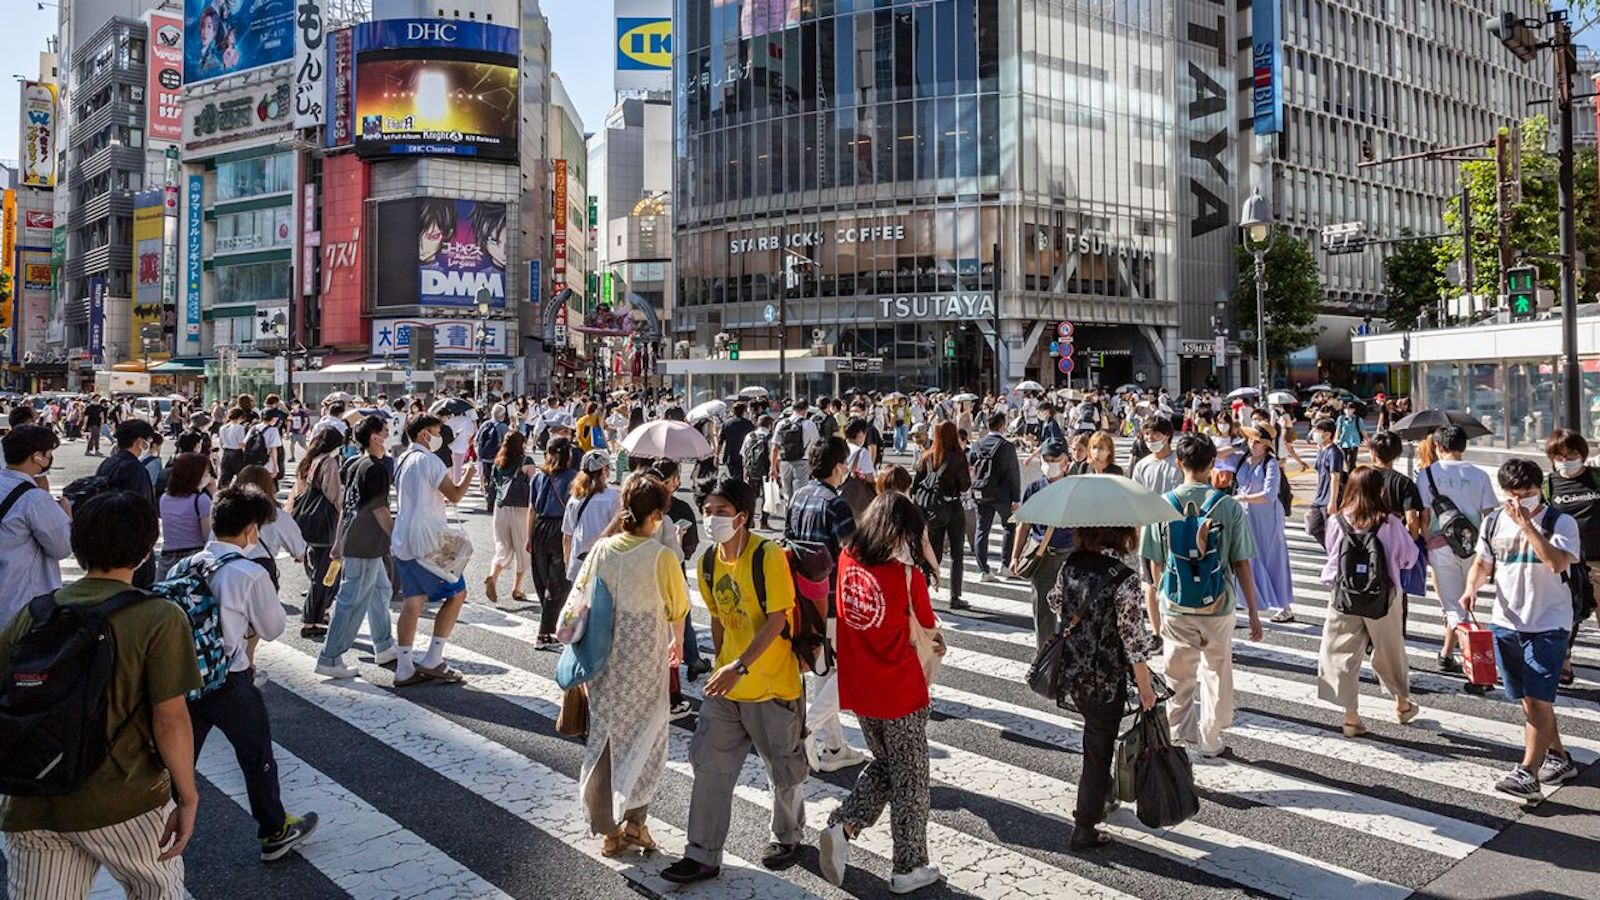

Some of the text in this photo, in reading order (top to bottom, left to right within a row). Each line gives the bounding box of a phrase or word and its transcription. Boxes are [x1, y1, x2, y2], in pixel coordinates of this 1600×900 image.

[407, 23, 457, 41] DHC
[297, 0, 322, 122] もんじゃ
[1254, 42, 1274, 118] SEIBU
[159, 92, 182, 106] B1F
[159, 105, 182, 119] B2F
[423, 130, 450, 142] Knight
[190, 193, 200, 280] サマーフルーツギフト
[835, 225, 905, 244] COFFEE
[1066, 233, 1152, 260] TSUTAYA
[324, 225, 360, 295] クスリ
[421, 269, 504, 298] DMM
[879, 295, 995, 318] TSUTAYA
[378, 325, 496, 348] 大盛書店
